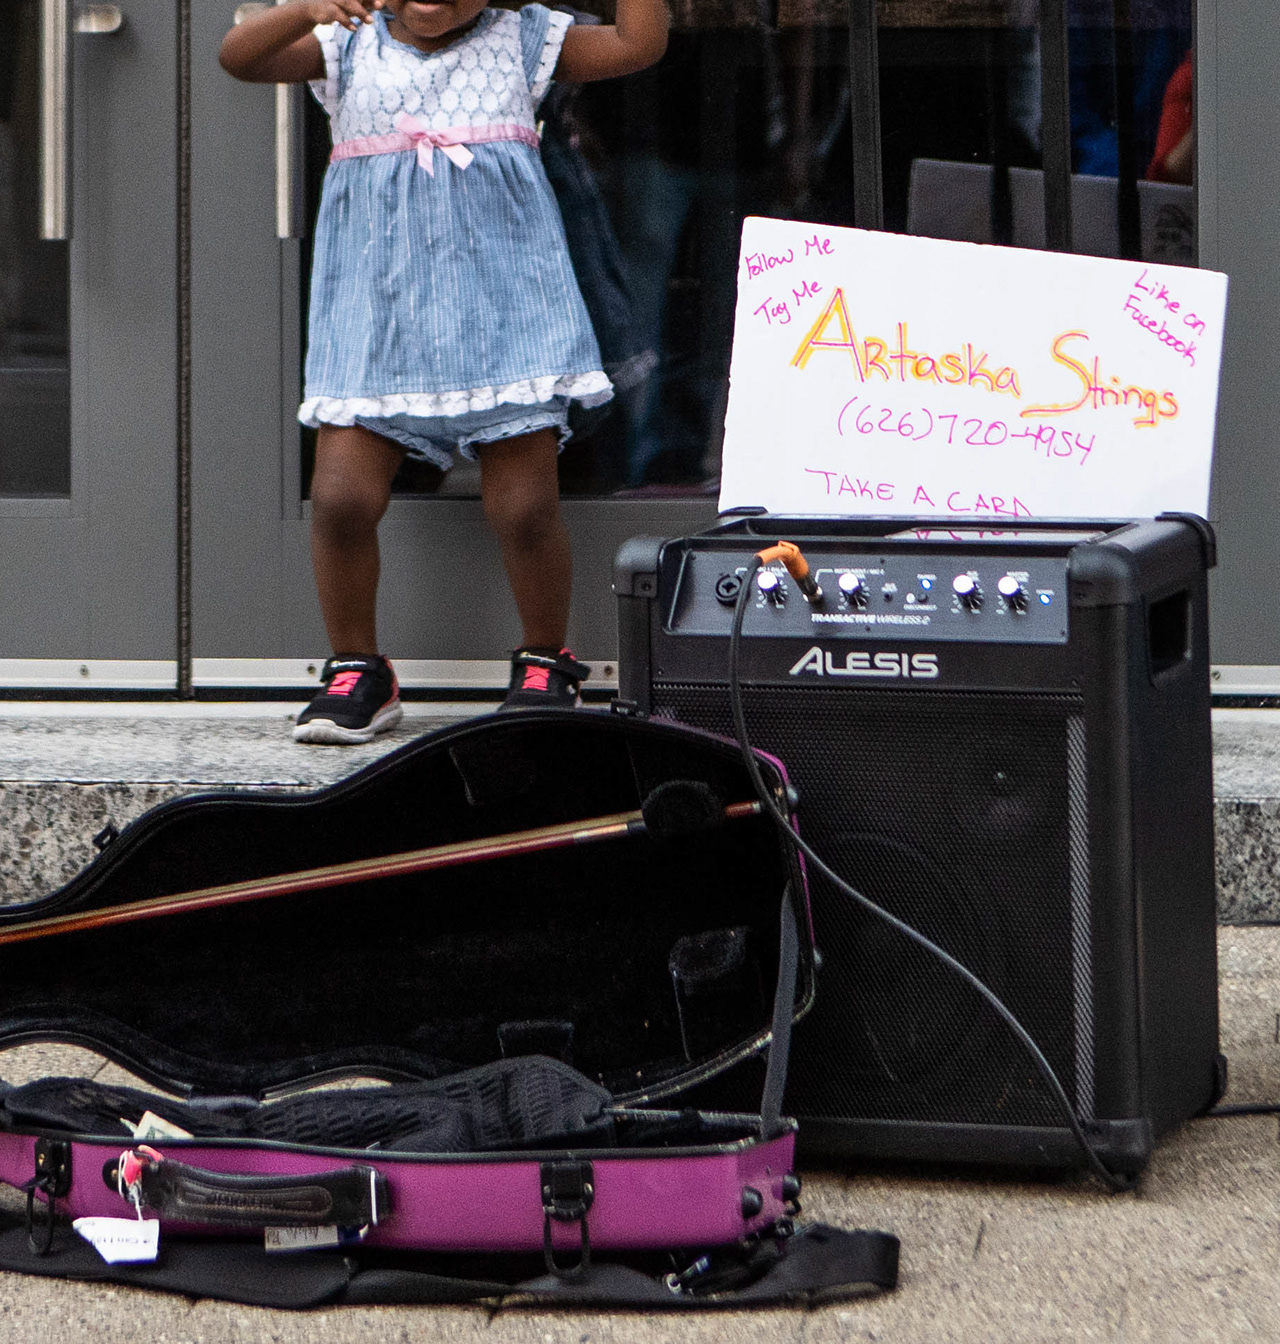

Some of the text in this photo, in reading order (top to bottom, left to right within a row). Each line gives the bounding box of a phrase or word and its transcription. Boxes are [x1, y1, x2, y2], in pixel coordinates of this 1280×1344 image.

[744, 235, 835, 280] Follow Me
[753, 280, 822, 324] Tag Me
[1134, 269, 1206, 336] Like on
[1123, 294, 1198, 367] Facebook
[1019, 329, 1179, 429] Strings
[804, 468, 895, 501] TAKE
[913, 485, 936, 507] A
[811, 613, 876, 624] TRANSACTIVE
[788, 646, 940, 678] ALESIS
